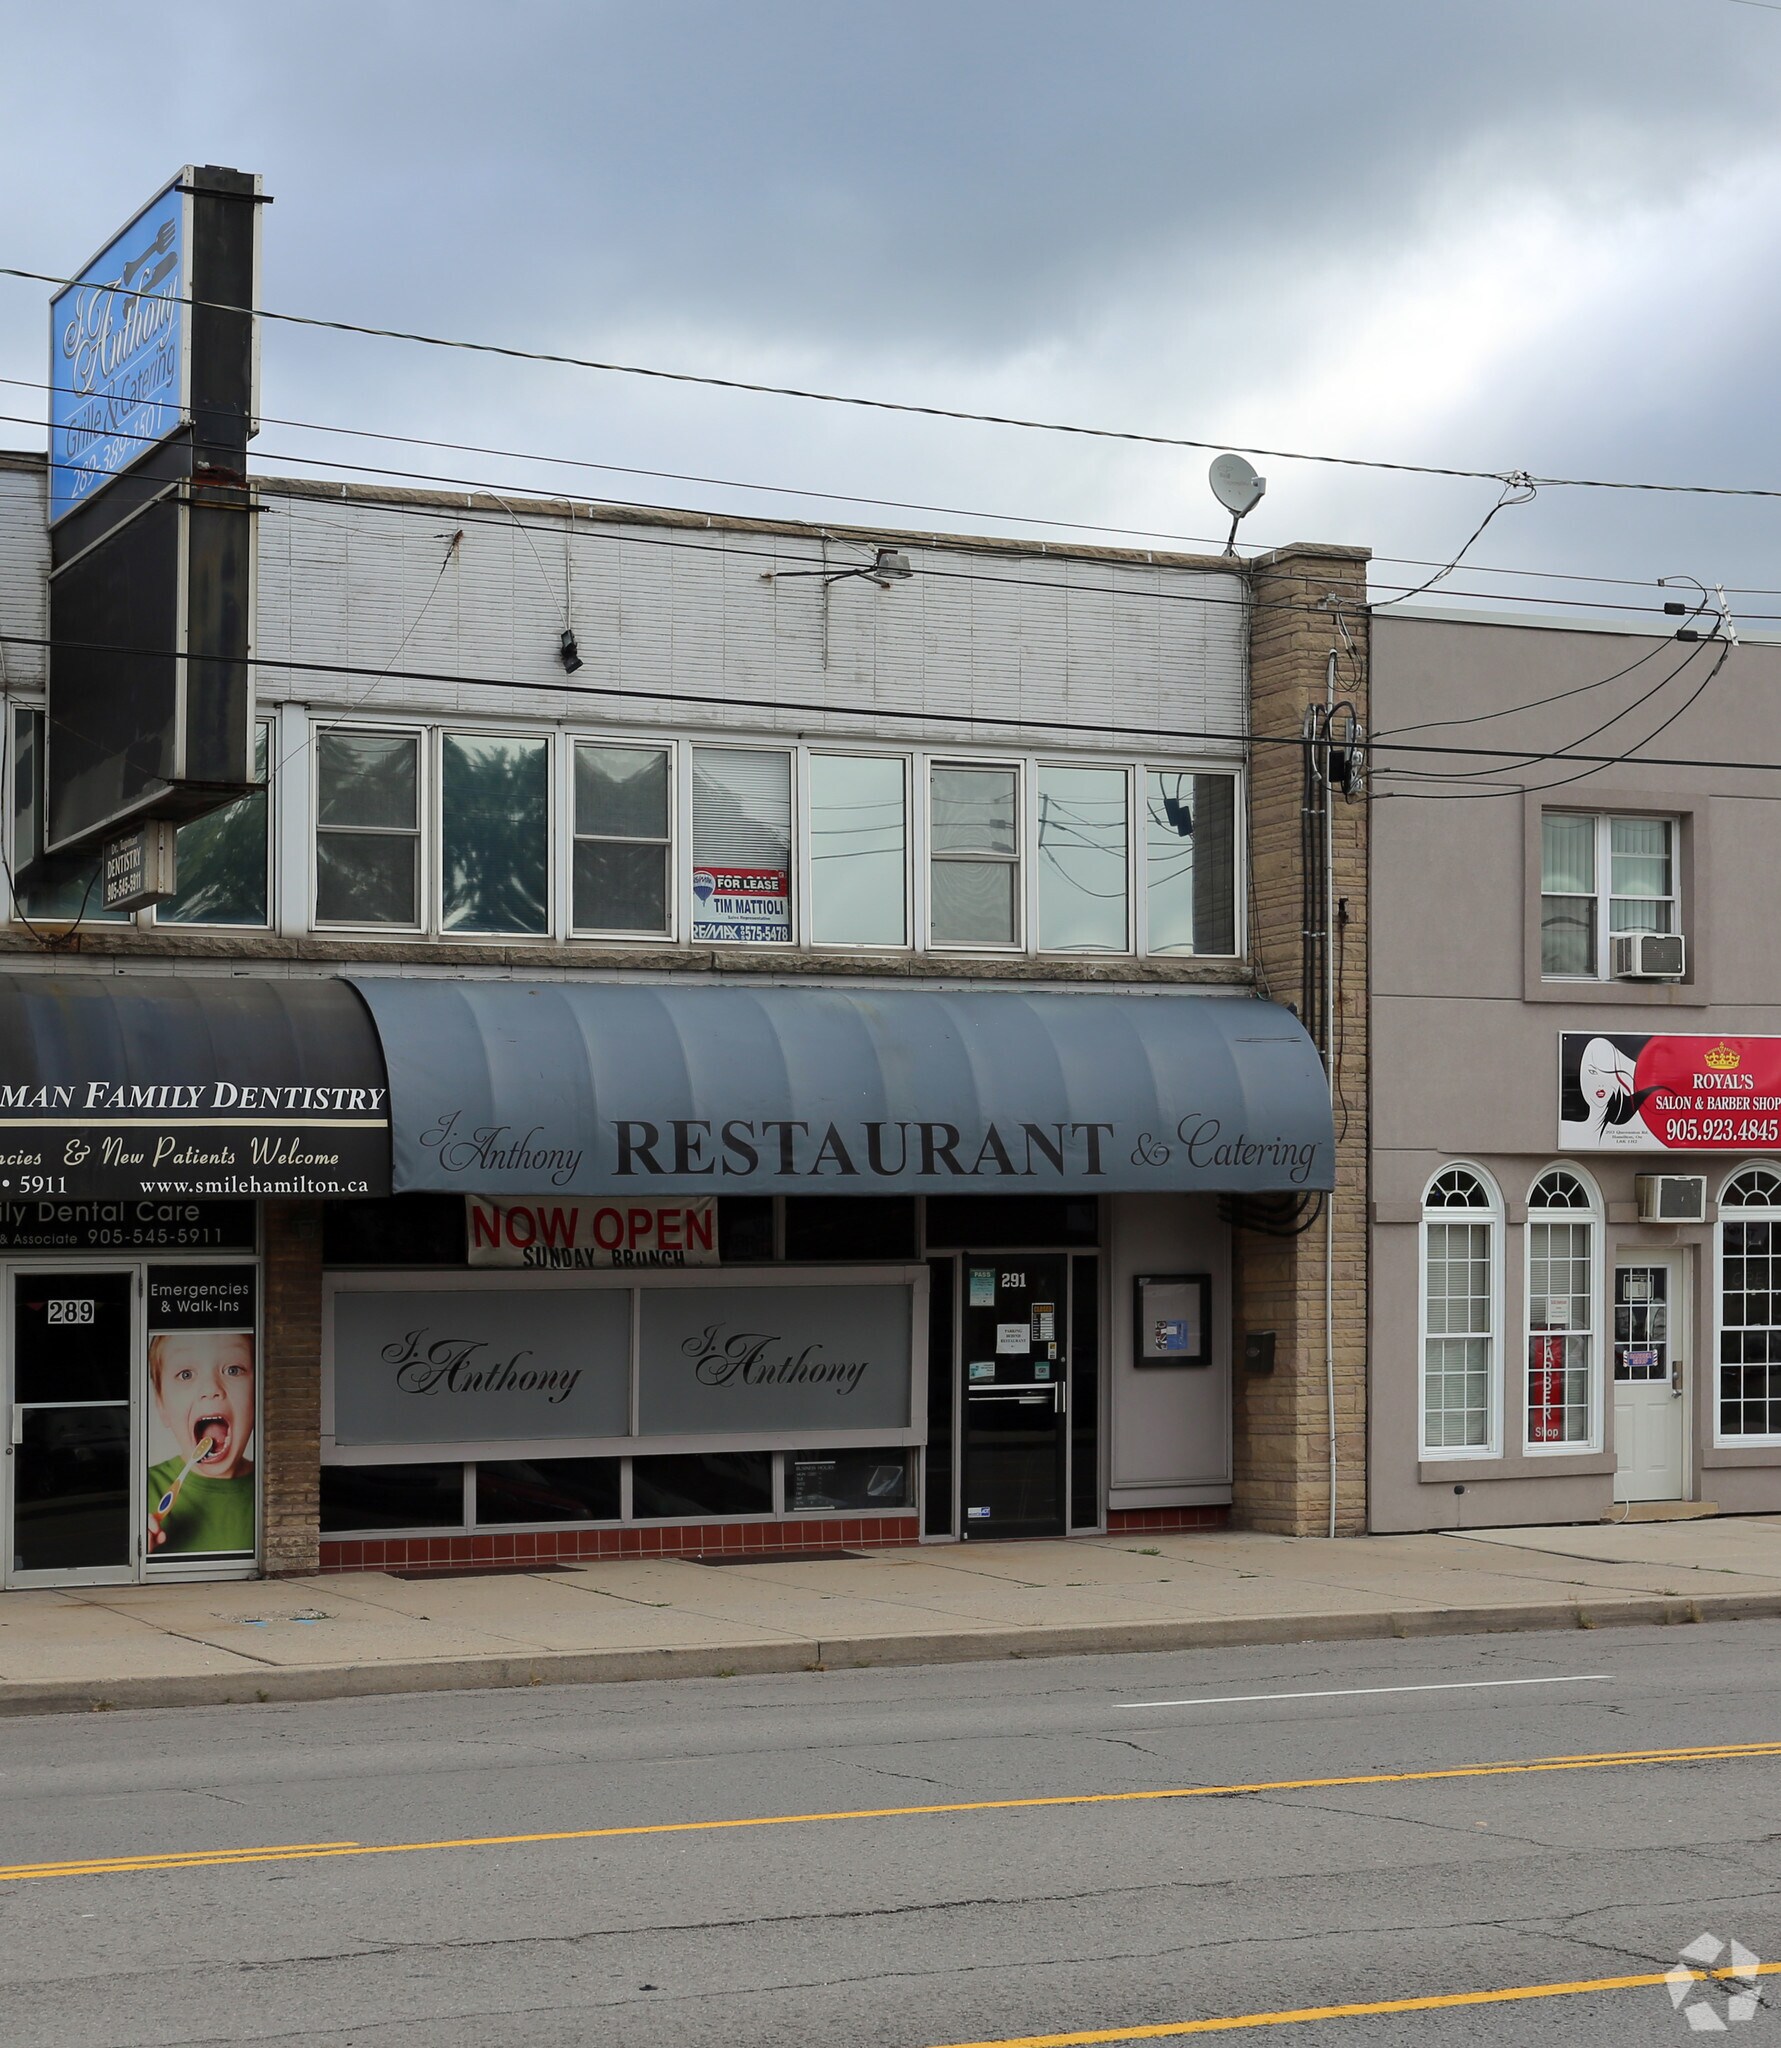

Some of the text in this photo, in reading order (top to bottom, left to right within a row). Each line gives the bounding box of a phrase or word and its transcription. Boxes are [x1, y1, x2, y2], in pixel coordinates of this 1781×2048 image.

[73, 267, 179, 398] Anthony
[66, 342, 175, 457] Grille & Catering
[71, 398, 163, 499] 289-389-1501
[107, 847, 141, 879] DENTISTRY
[717, 879, 740, 889] FOR
[743, 880, 779, 890] LEASE
[714, 898, 784, 915] TIM MATTIOLI
[1692, 1073, 1754, 1090] ROYAL'S
[82, 1081, 207, 1110] FAMILY
[210, 1081, 387, 1111] DENTISTRY
[1655, 1096, 1781, 1111] SALON & BARBER SHOP
[1666, 1118, 1779, 1141] 905.923.4845
[63, 1138, 91, 1167] &
[101, 1136, 144, 1166] New
[152, 1136, 236, 1168] Patients
[250, 1136, 340, 1167] Welcome
[439, 1126, 584, 1187] Anthony
[610, 1120, 1115, 1177] RESTAURANT
[1130, 1132, 1171, 1167] &
[1177, 1112, 1322, 1184] Catering
[19, 1175, 369, 1195] 5911 www.smilehamilton.ca
[38, 1201, 125, 1223] Dental
[136, 1202, 200, 1223] Care
[13, 1232, 78, 1246] Associate
[88, 1227, 222, 1245] 905-545-5911
[472, 1205, 714, 1251] NOW OPEN
[522, 1246, 686, 1269] SUNDAY BRUNCH
[151, 1283, 249, 1300] Emergencies
[1001, 1272, 1027, 1288] 291
[49, 1301, 94, 1324] 289
[161, 1299, 239, 1313] & Walk-Ins
[396, 1338, 583, 1404] Anthony
[694, 1332, 871, 1396] Anthony
